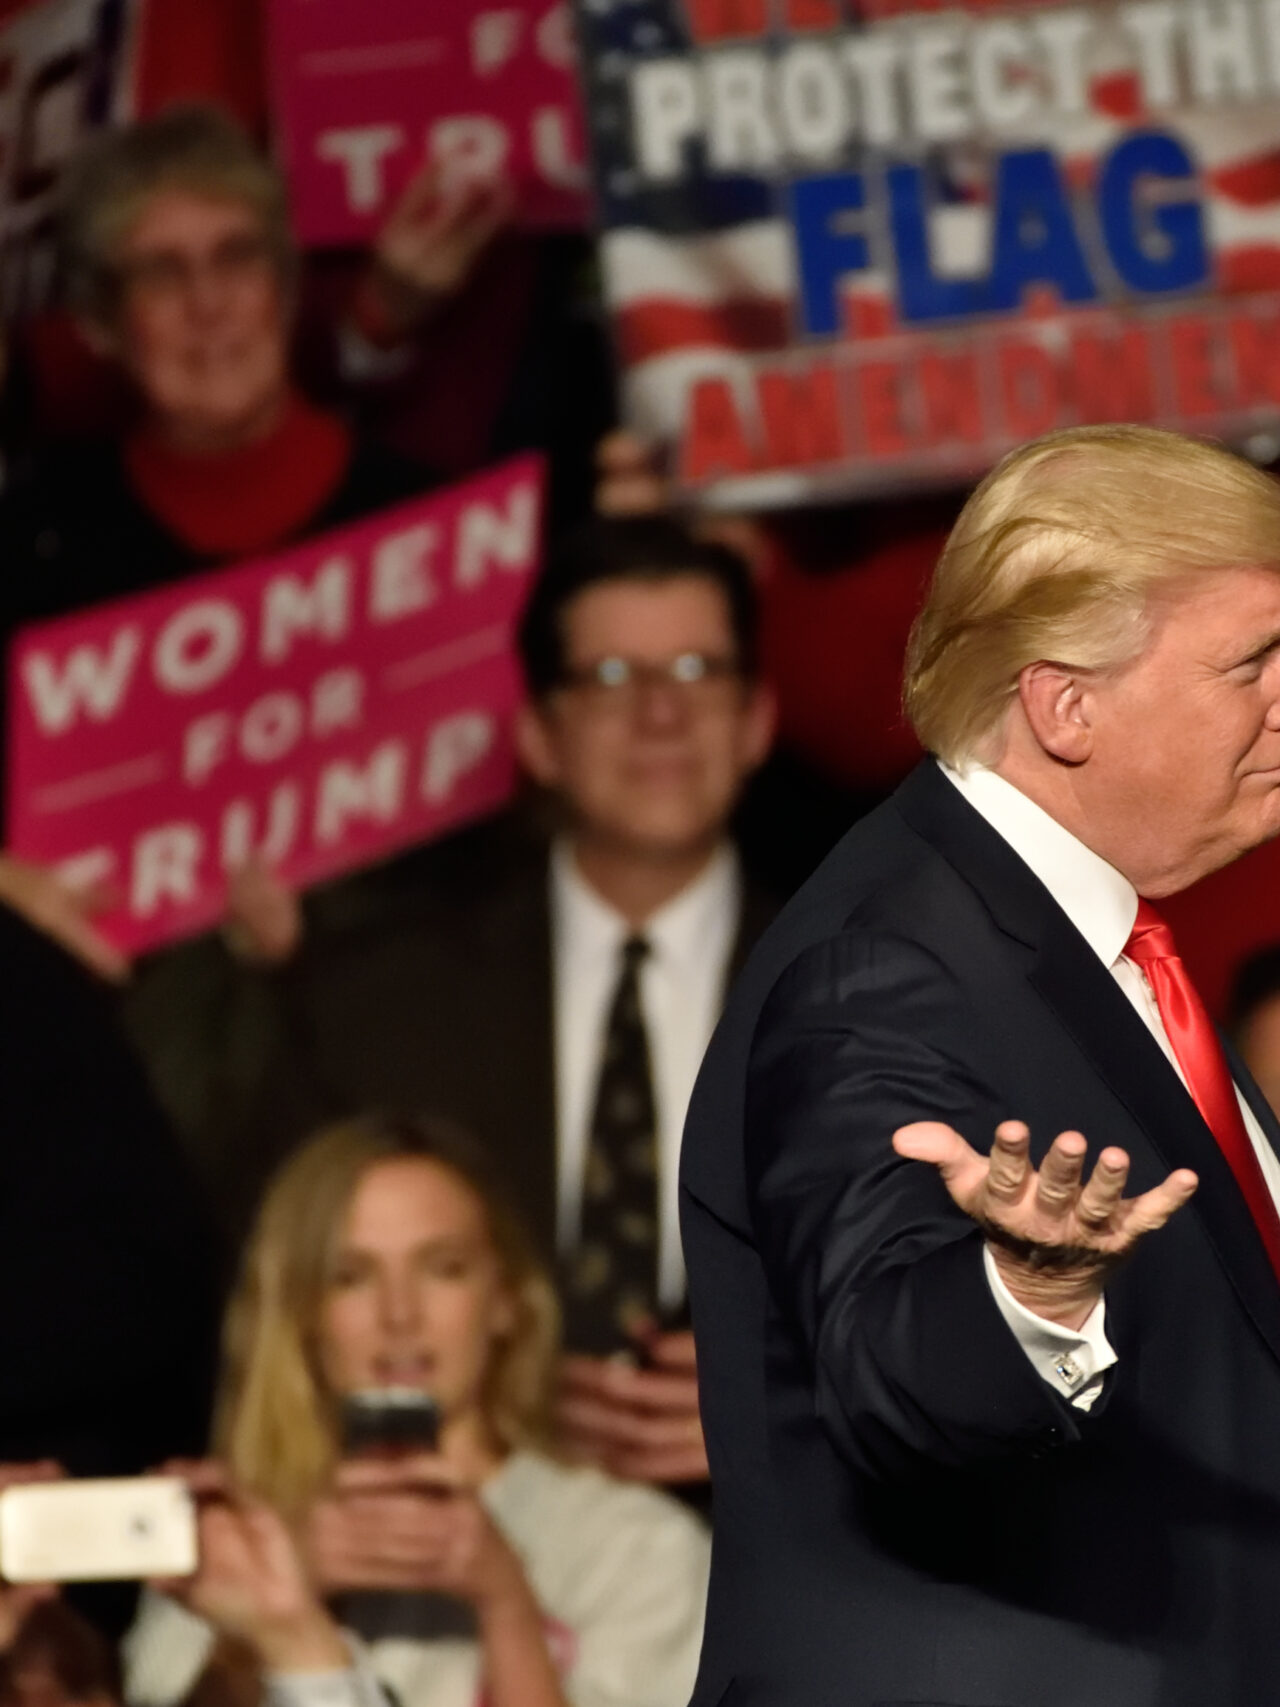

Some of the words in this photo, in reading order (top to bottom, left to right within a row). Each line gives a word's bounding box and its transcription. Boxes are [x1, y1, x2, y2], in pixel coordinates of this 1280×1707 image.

[315, 107, 594, 213] TRU
[632, 14, 1094, 178] PROTECT
[790, 128, 1210, 335] FLAG
[23, 482, 537, 735] WOMEN
[183, 668, 363, 786] FOR
